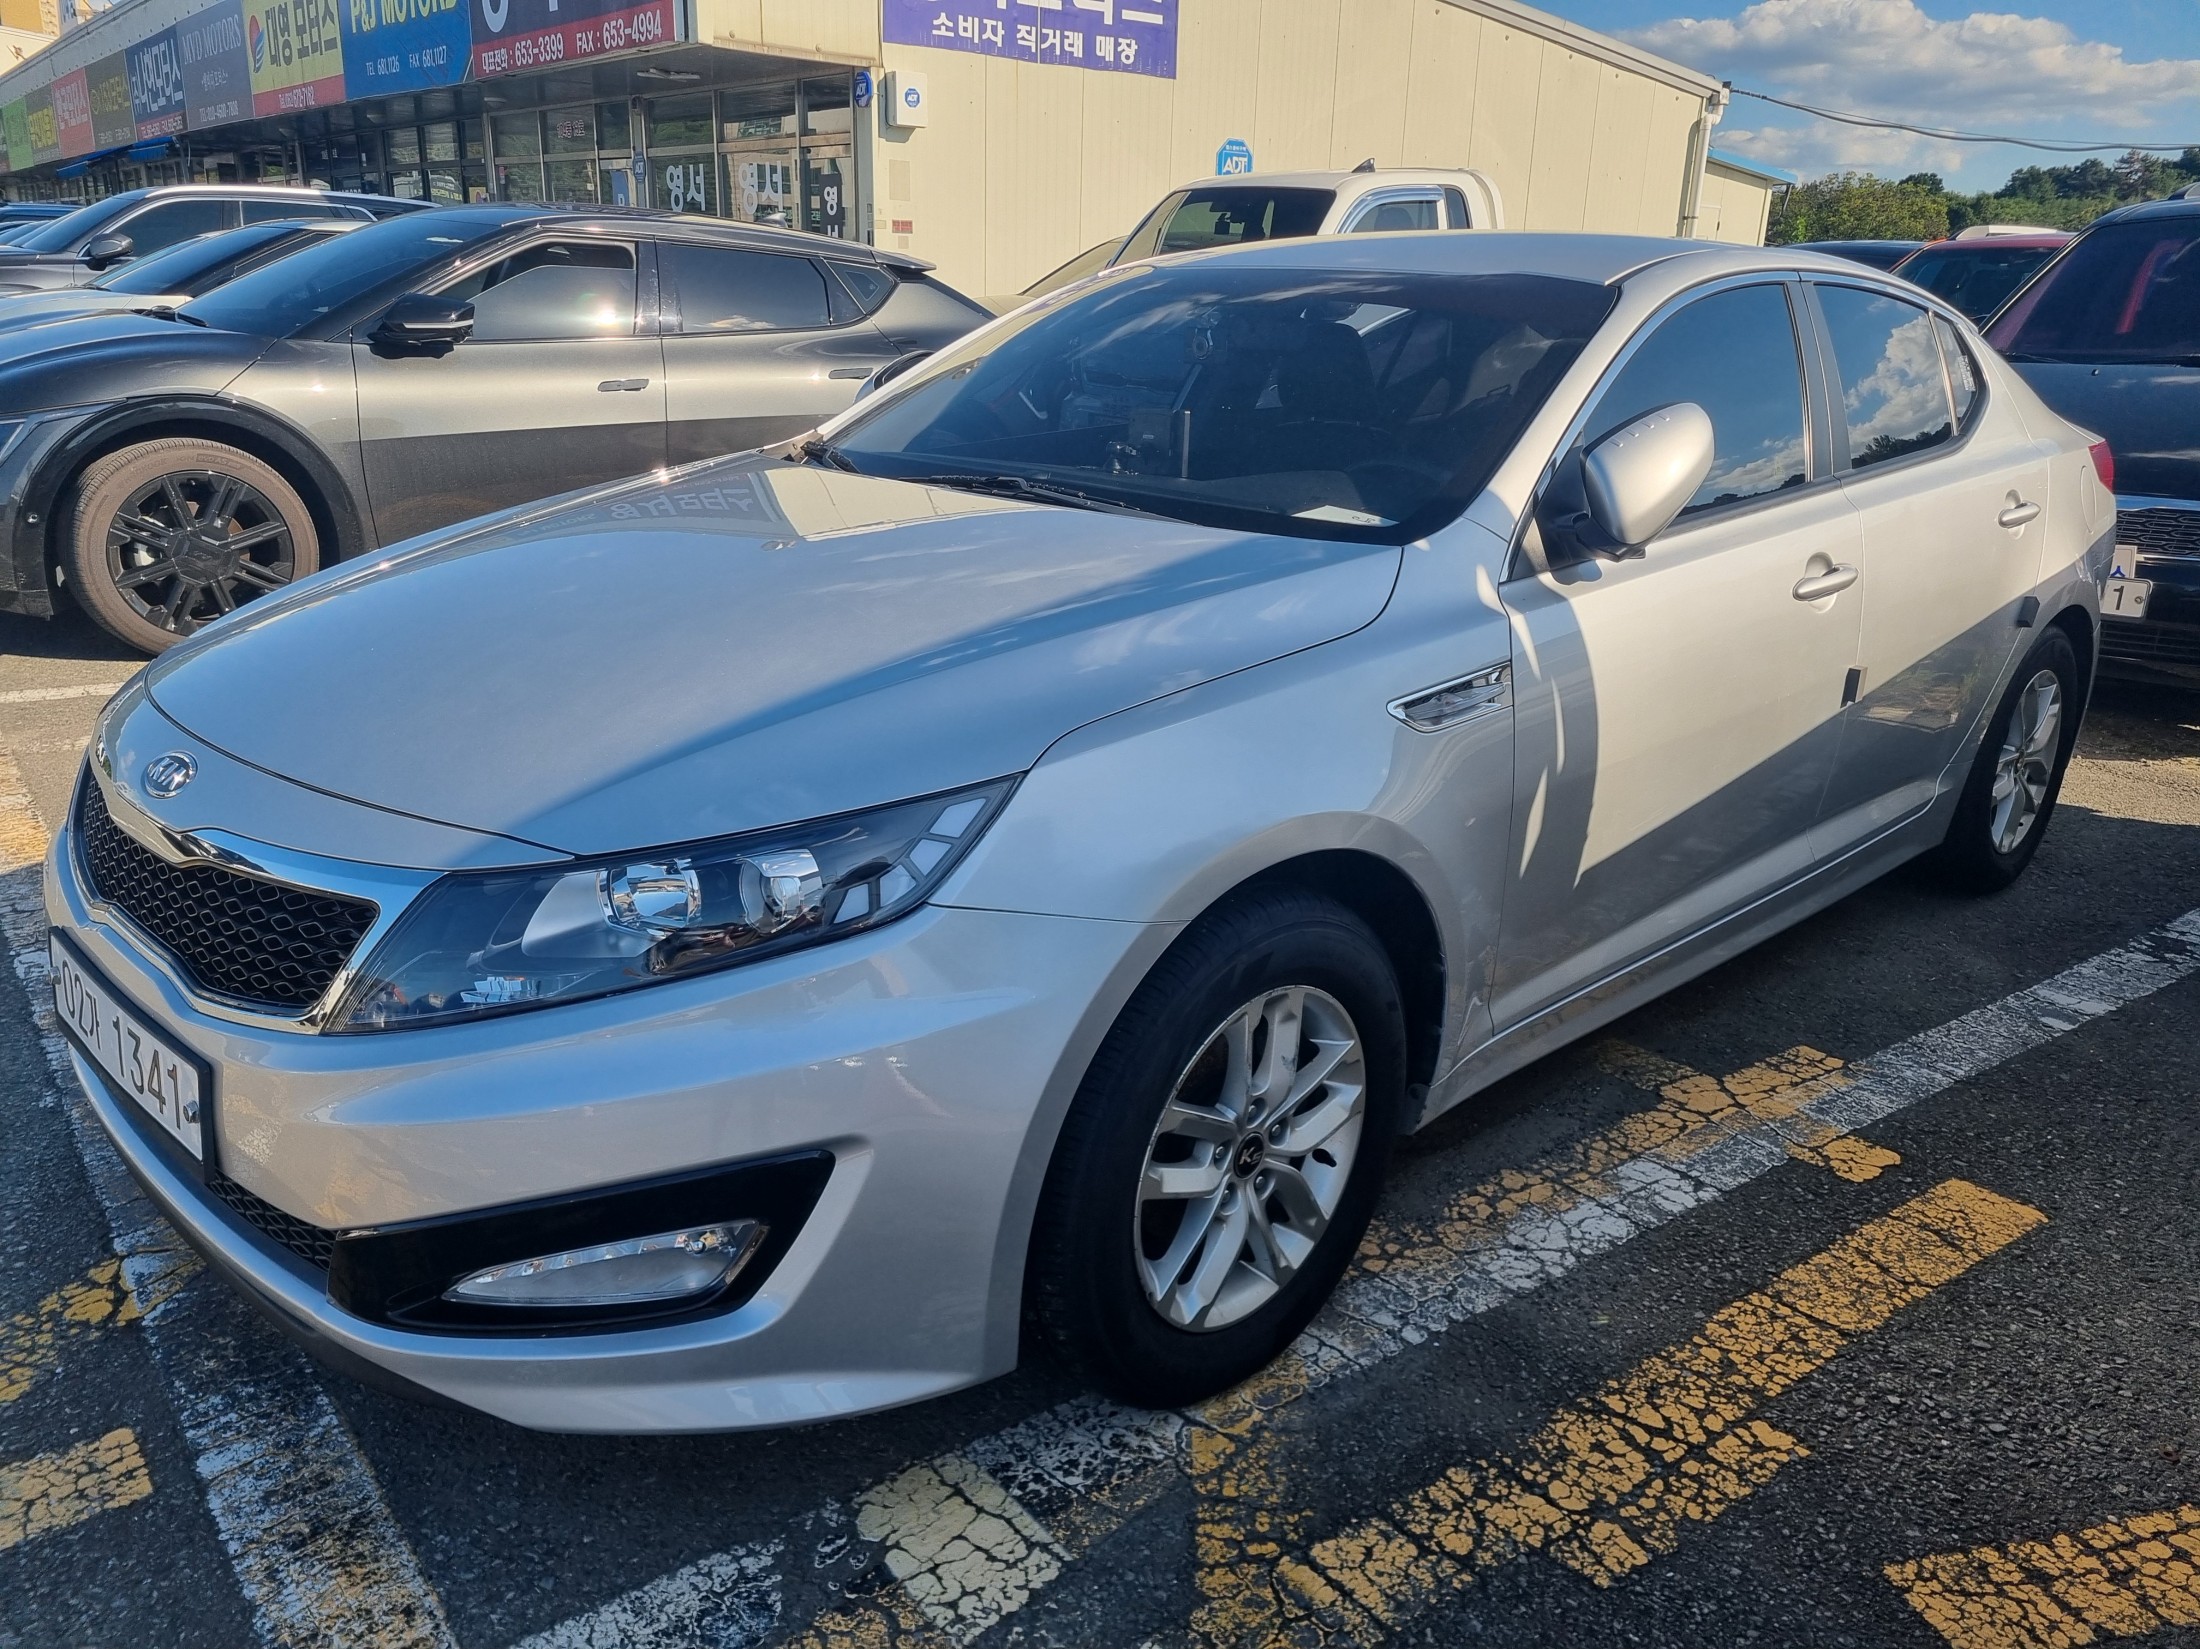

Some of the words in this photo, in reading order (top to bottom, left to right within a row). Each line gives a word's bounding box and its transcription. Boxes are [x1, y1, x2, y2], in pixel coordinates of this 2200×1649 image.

[202, 16, 242, 59] MOTORS
[264, 1, 293, 67] 대영
[293, 0, 338, 60] 모터스
[481, 50, 508, 74] 대표전화
[514, 32, 565, 68] 653-3399
[576, 30, 595, 55] FAX
[603, 8, 663, 50] 653-4994
[931, 11, 1005, 48] 소비자
[1016, 23, 1084, 59] 직거래
[1095, 34, 1138, 65] 매장
[365, 61, 376, 77] TEL
[409, 52, 421, 69] FAX
[855, 83, 867, 97] ADT
[1222, 156, 1248, 174] ADT
[665, 163, 706, 213] 영서
[738, 160, 783, 216] 영서
[2112, 585, 2126, 611] 1
[149, 757, 187, 791] KIA
[61, 959, 101, 1051] 02가
[112, 1014, 181, 1130] 1341
[1239, 1146, 1263, 1165] K5
